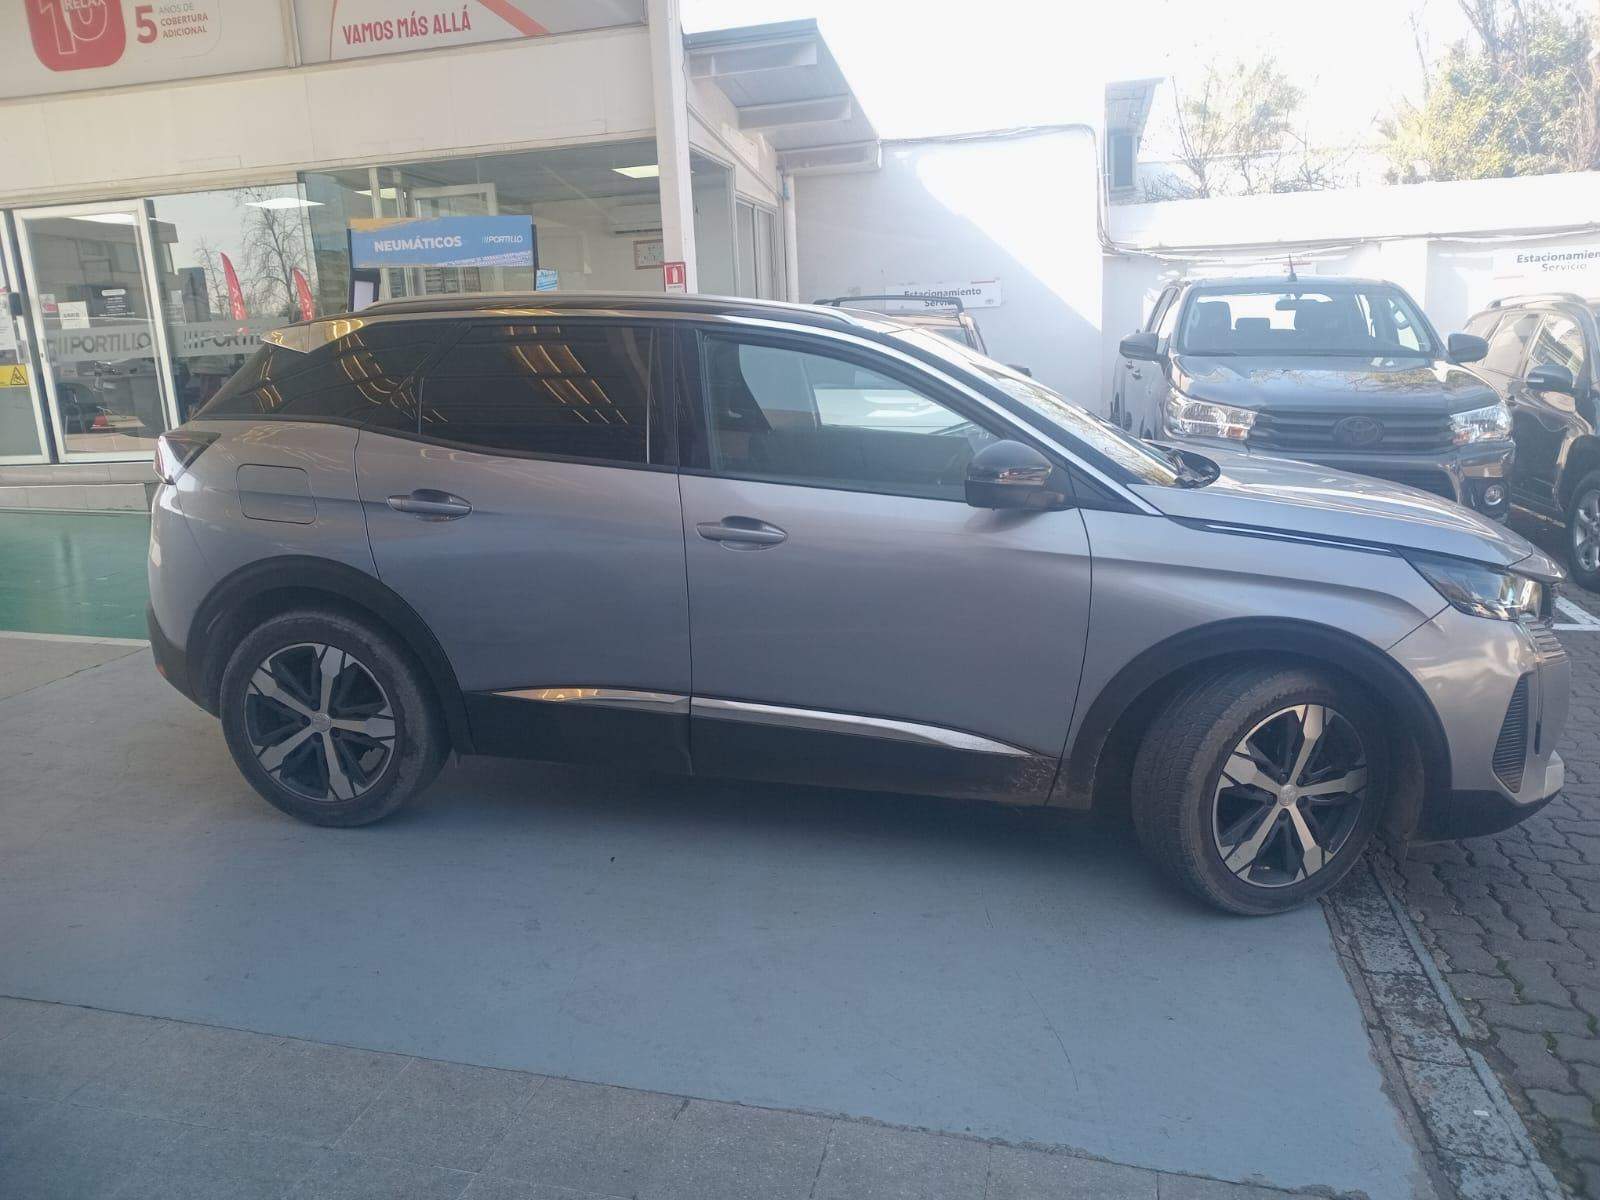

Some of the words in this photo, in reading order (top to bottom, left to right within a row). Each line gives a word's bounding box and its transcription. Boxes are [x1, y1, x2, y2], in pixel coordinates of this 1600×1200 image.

[183, 2, 194, 12] DE
[135, 5, 157, 43] 5
[160, 13, 208, 26] COBERTURA
[342, 20, 393, 44] VAMOS
[397, 10, 428, 38] MÁS
[433, 4, 471, 34] ALLÁ
[162, 25, 207, 38] ADICIONAL
[373, 234, 462, 252] NEUMÁTICOS
[488, 234, 523, 244] PORTILLO
[1542, 262, 1588, 272] Servicio
